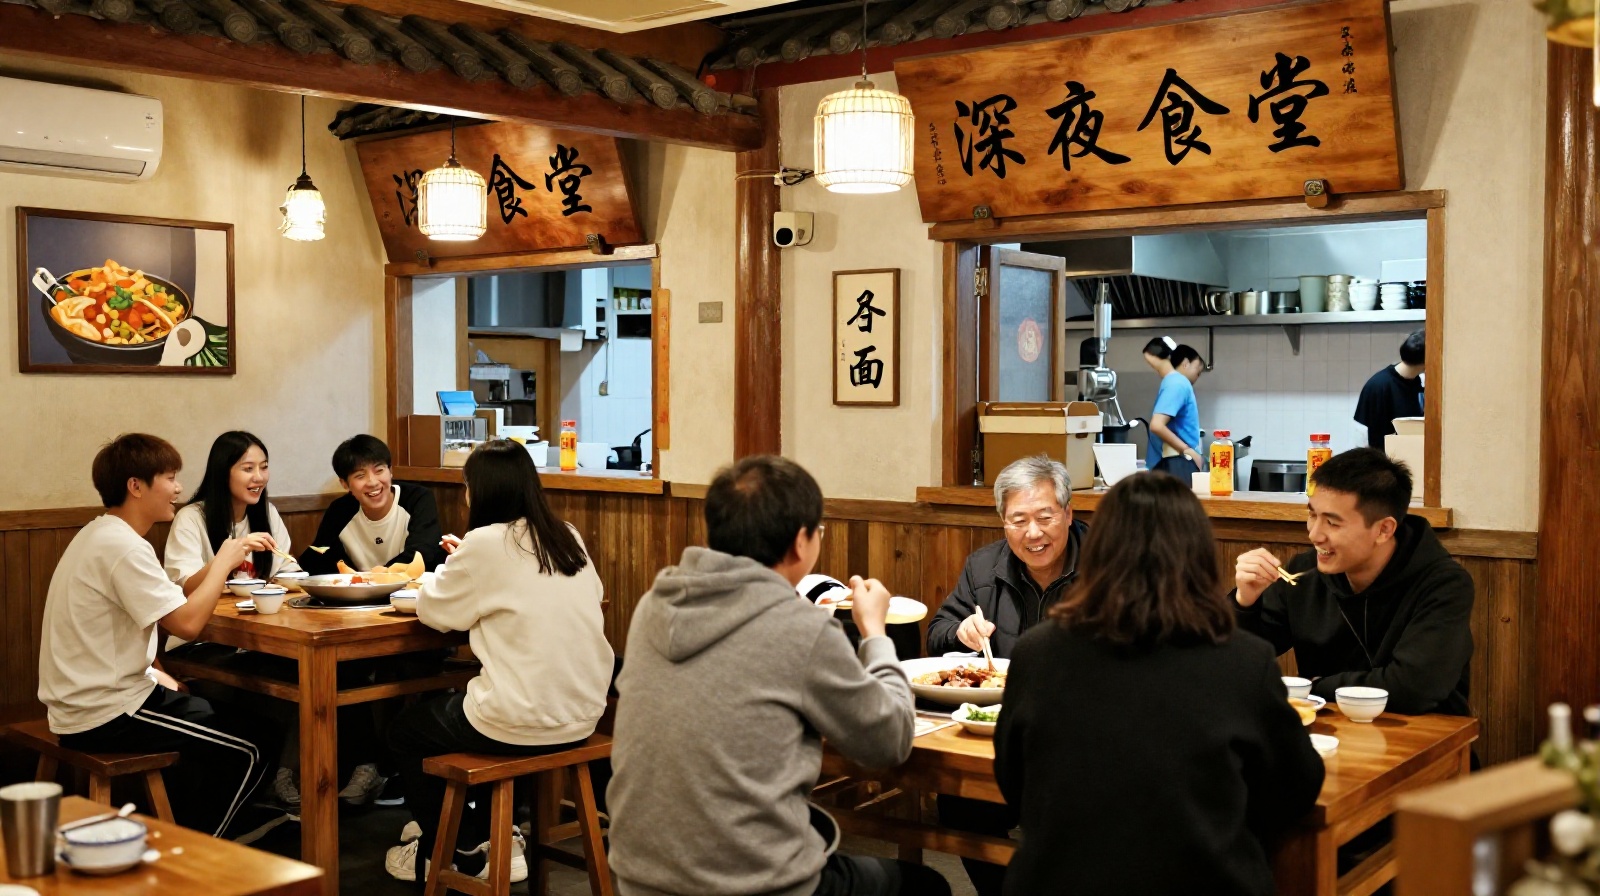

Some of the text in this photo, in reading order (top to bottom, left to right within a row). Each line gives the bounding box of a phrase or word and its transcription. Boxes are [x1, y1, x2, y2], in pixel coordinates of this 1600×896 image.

[953, 51, 1330, 180] 深夜食堂
[392, 143, 593, 227] 深食堂
